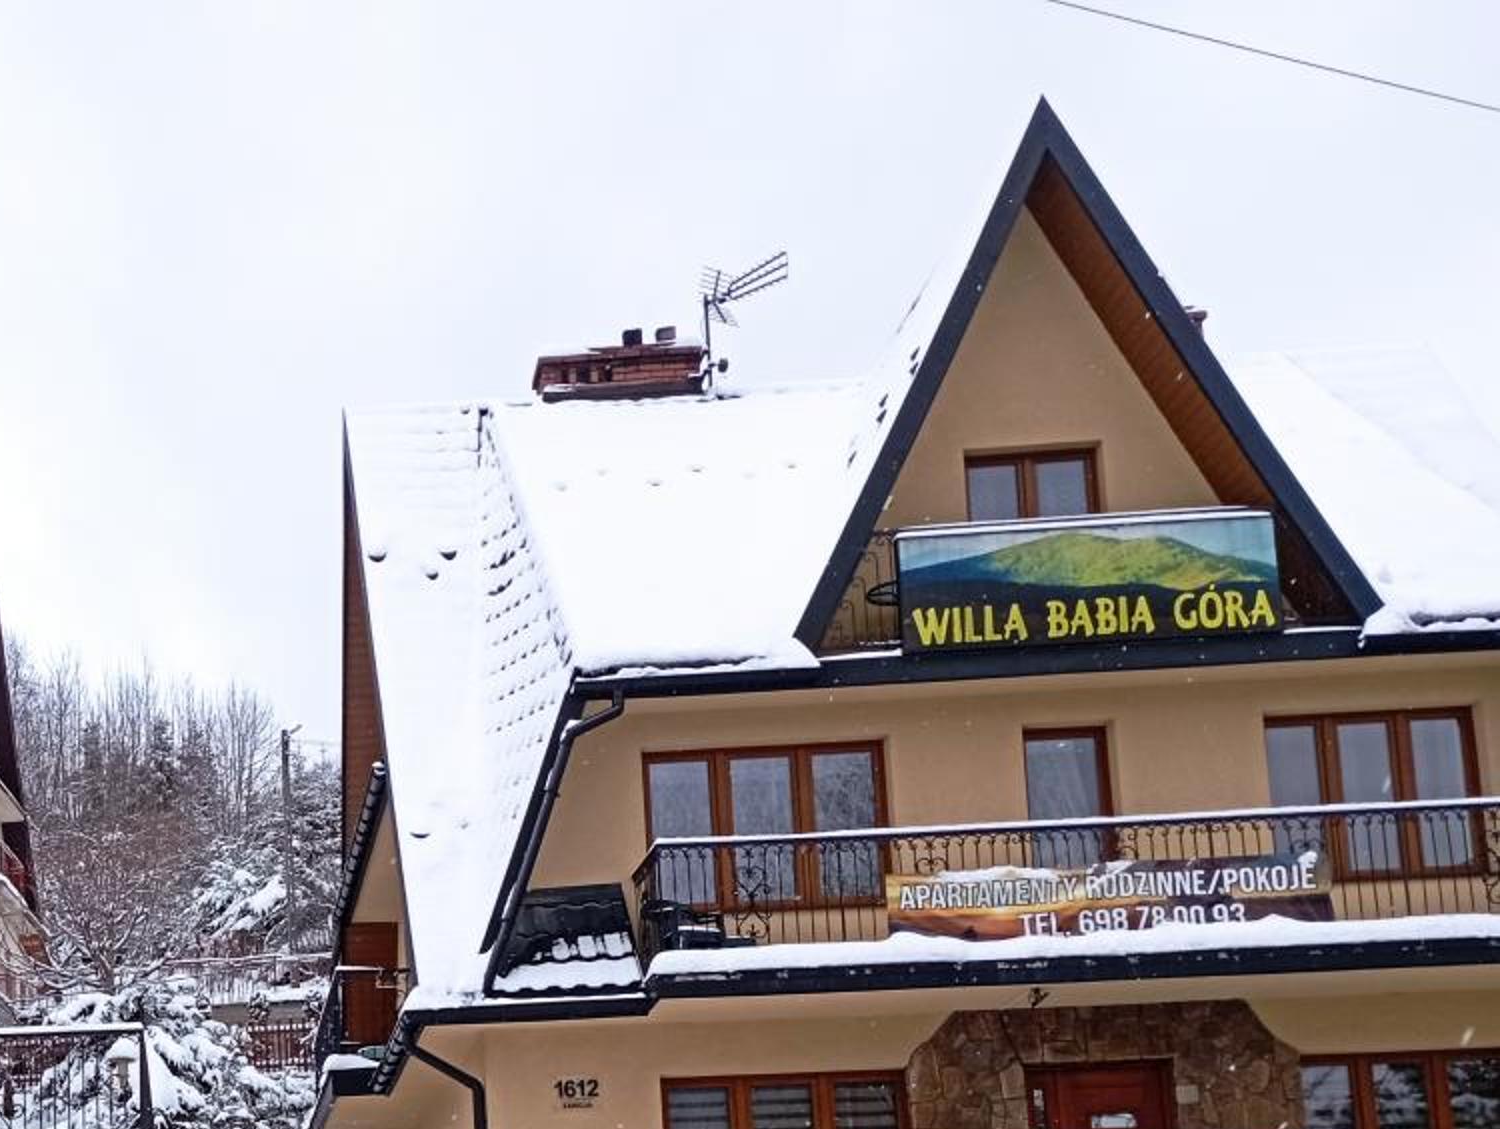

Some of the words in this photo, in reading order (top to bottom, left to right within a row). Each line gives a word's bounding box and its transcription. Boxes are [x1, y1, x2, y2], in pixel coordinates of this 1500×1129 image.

[911, 602, 1028, 646] WILLA
[1046, 595, 1155, 639] BABIA
[1172, 583, 1277, 631] GÓRA
[900, 877, 1078, 910] APARTAMENTY
[1020, 912, 1071, 936] TEL.
[1079, 907, 1129, 933] 698
[1135, 905, 1166, 931] 78
[1212, 903, 1246, 924] 93
[553, 1079, 599, 1098] 1612
